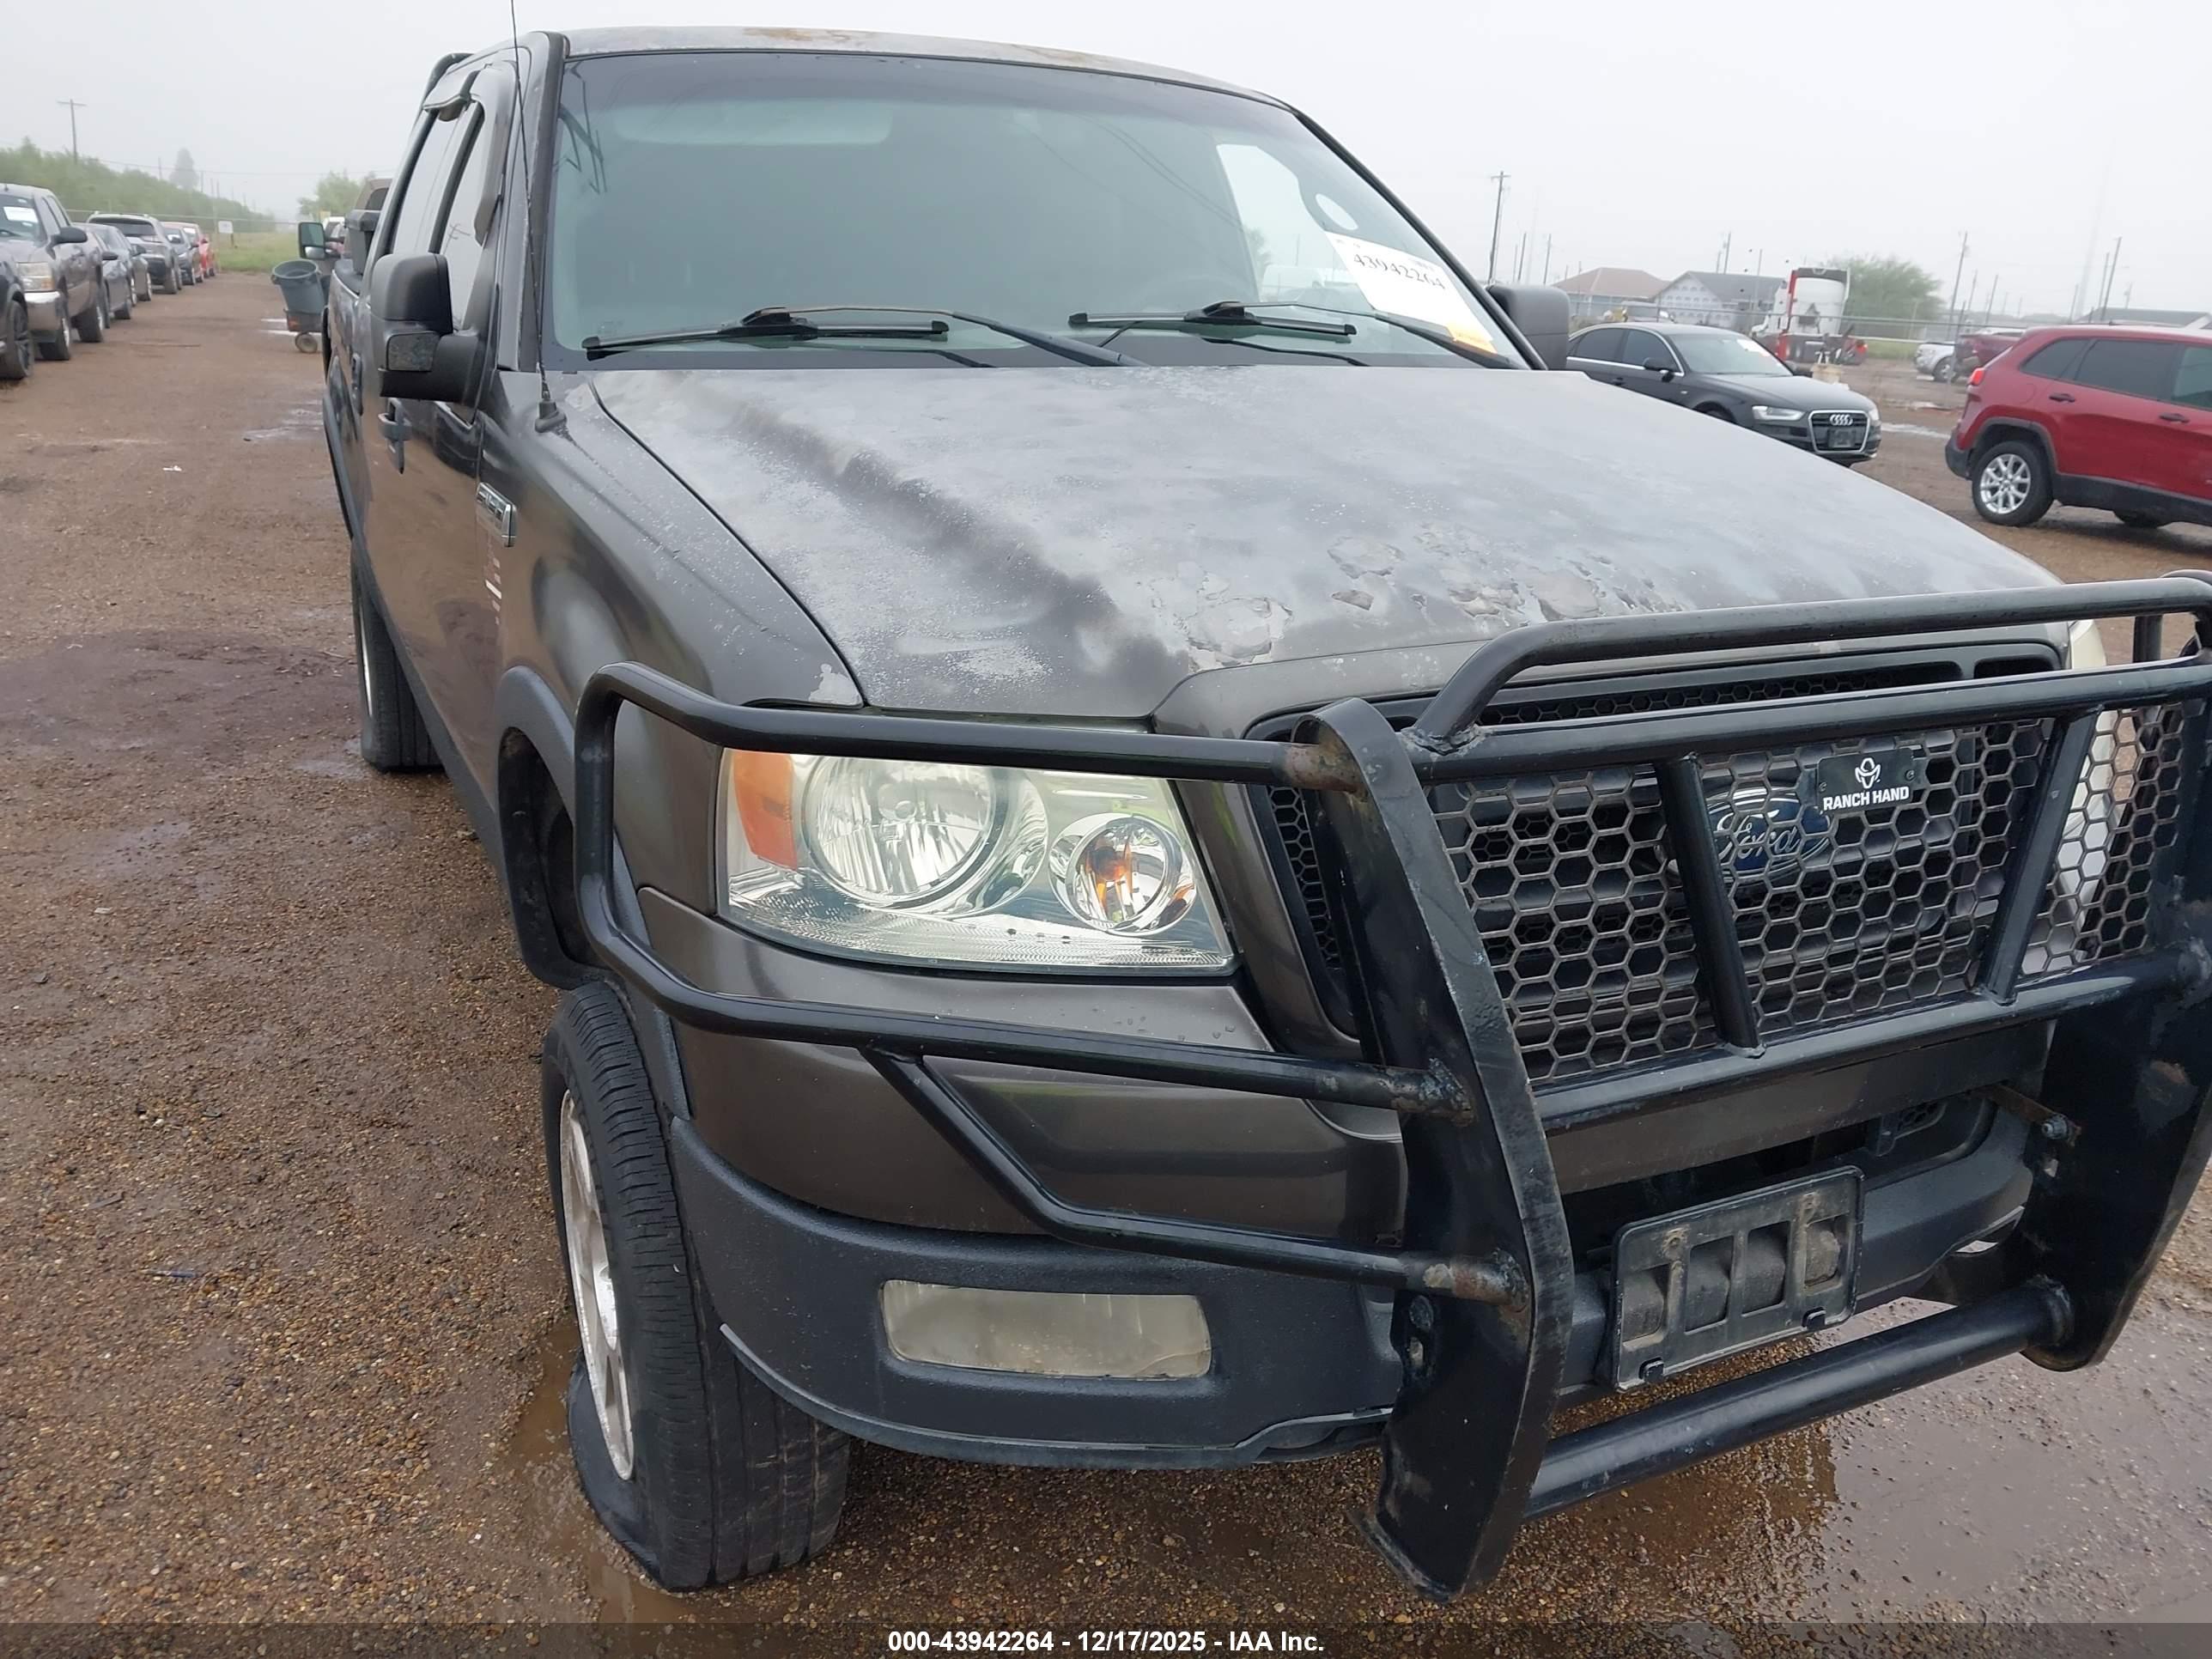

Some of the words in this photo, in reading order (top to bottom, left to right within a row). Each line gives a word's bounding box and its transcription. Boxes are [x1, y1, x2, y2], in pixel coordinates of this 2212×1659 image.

[1822, 793, 1871, 811] RANCH
[1872, 786, 1910, 805] HAND
[1717, 809, 1802, 859] Ford
